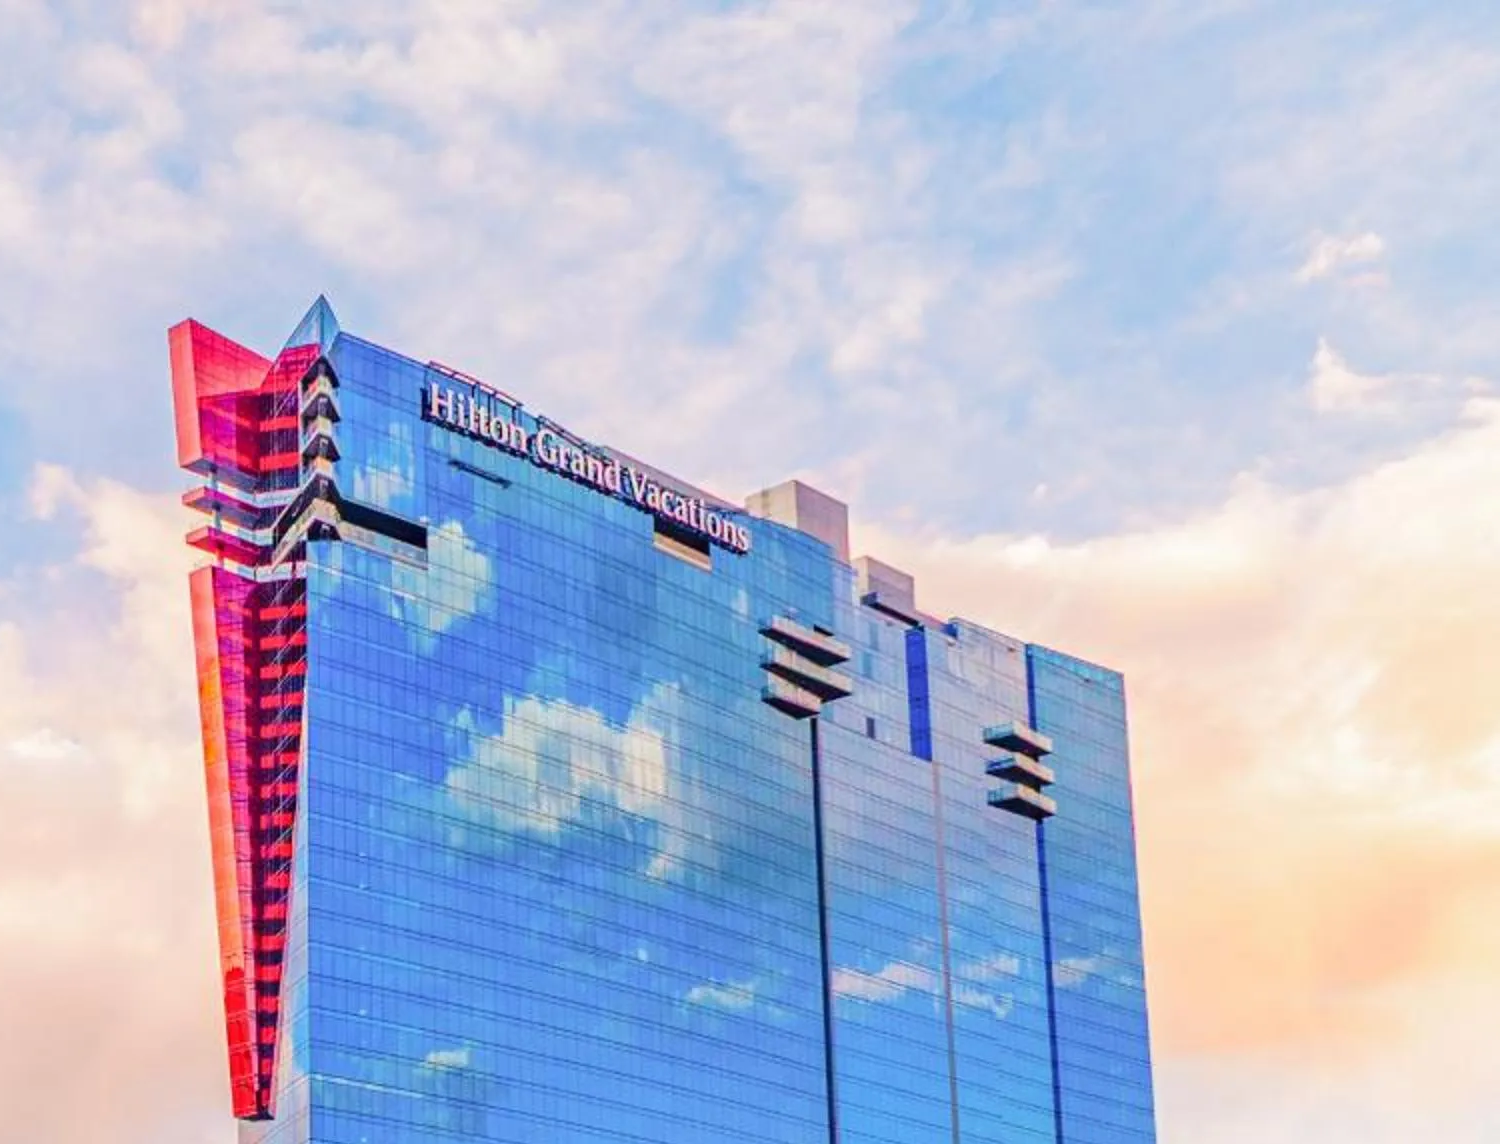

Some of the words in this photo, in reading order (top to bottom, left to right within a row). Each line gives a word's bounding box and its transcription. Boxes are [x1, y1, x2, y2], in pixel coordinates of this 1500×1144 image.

[429, 382, 527, 454] Hilton
[537, 428, 622, 492] Grand
[629, 467, 749, 552] Vacations
